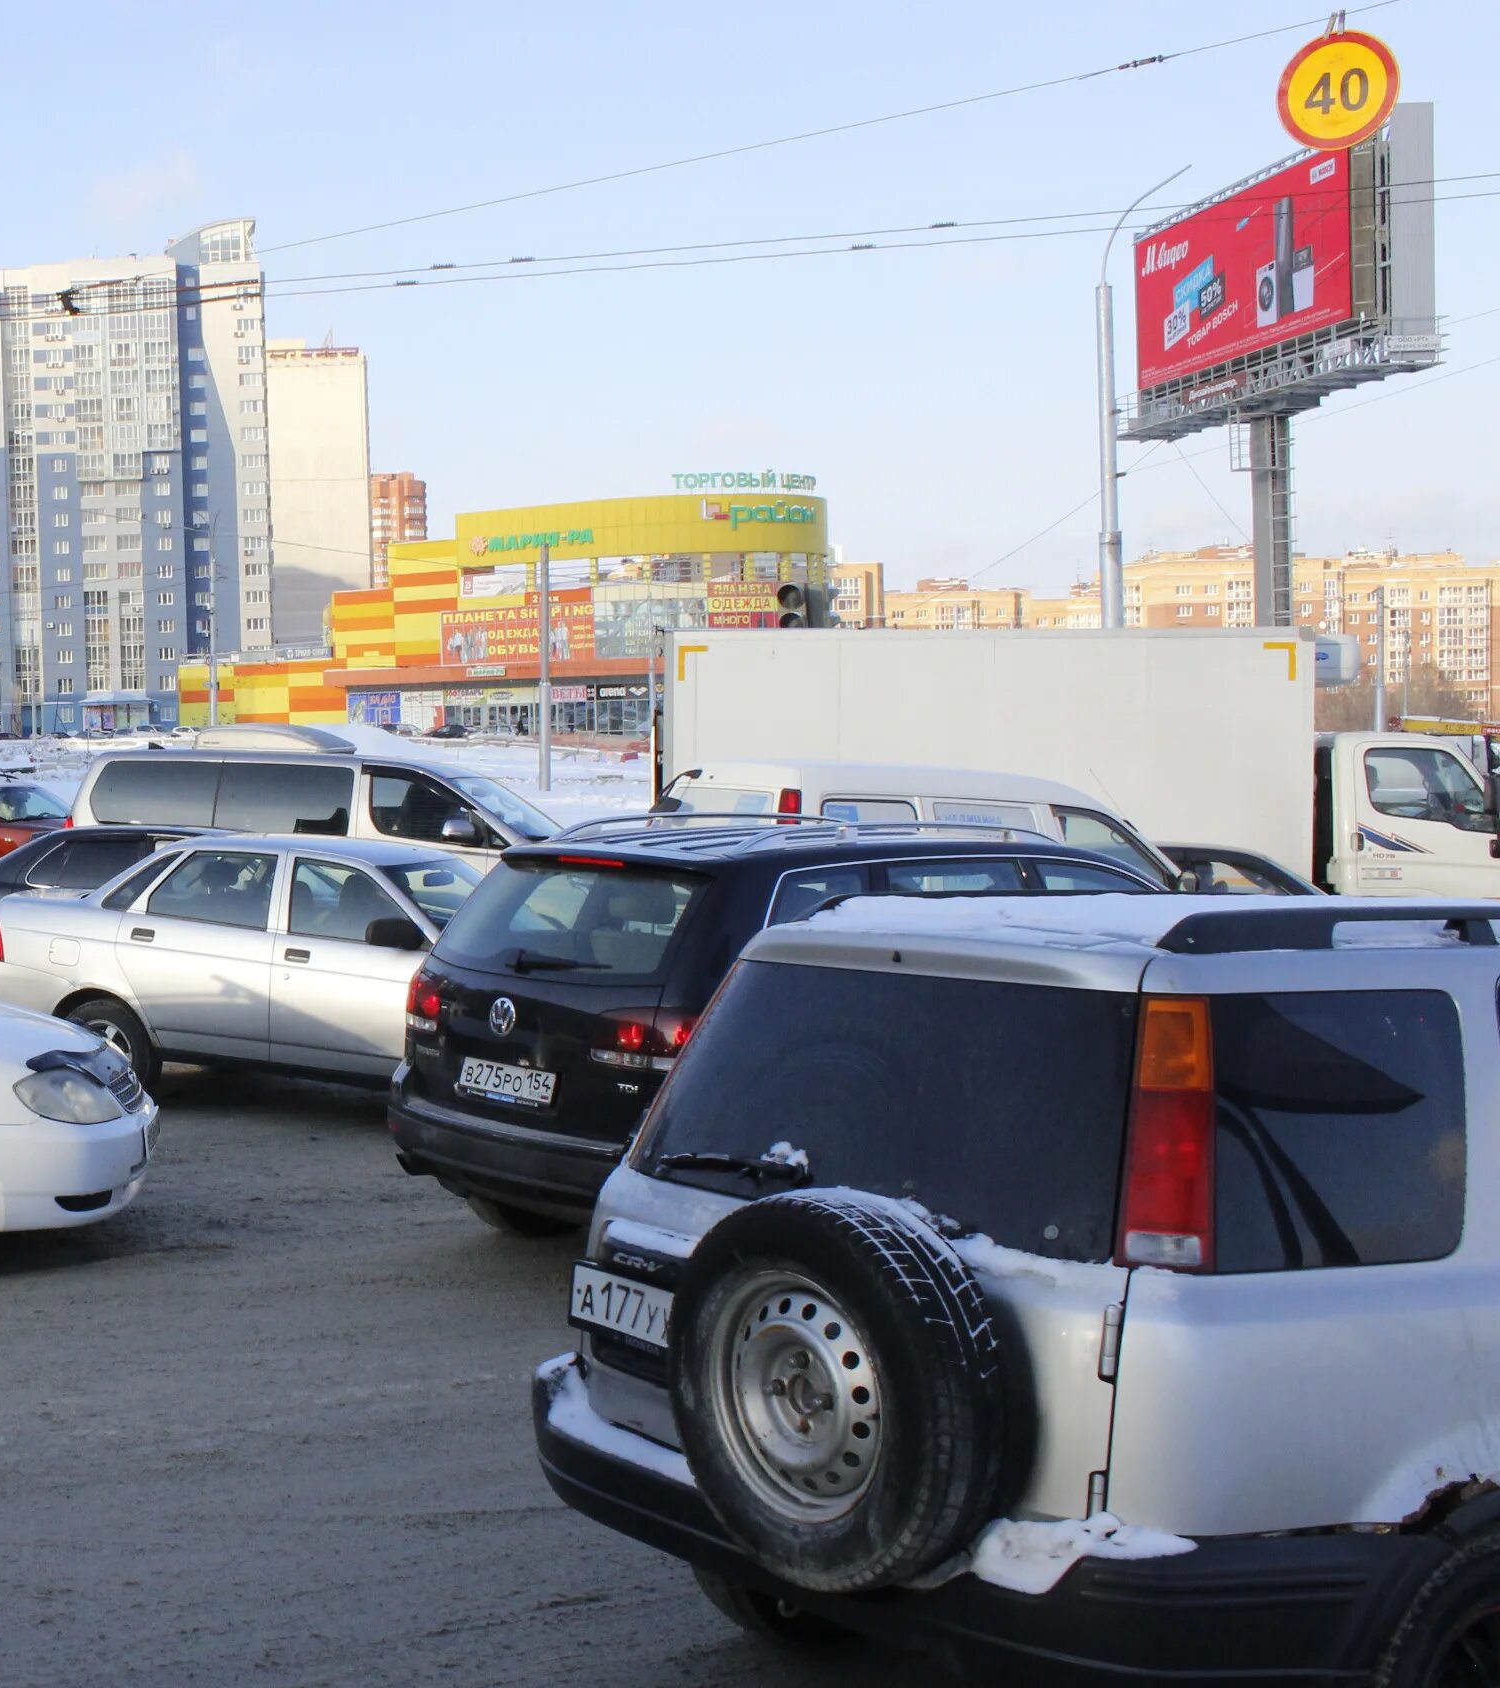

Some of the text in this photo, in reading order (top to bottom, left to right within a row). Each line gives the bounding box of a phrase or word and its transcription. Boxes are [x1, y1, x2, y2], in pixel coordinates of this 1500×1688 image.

[1304, 67, 1369, 115] 40
[1201, 278, 1222, 308] 50%
[1167, 308, 1187, 335] 30%
[1187, 321, 1212, 348] ТОВАР
[1212, 299, 1238, 328] BOSCH
[672, 469, 816, 491] ТОРГОВЫЙ ЦЕНТР
[487, 528, 594, 552] МАРИЯ-РА
[713, 584, 772, 595] ПЛАНЕТА
[532, 594, 540, 603] 2
[711, 598, 771, 610] ОДЕЖДА
[443, 610, 516, 624] ПЛАНЕТА
[713, 615, 750, 625] МНОГО
[487, 629, 539, 640] ОДЕЖДА
[488, 644, 539, 655] ОБУВЬ
[552, 687, 586, 699] ВЕТЫ
[600, 686, 626, 697] arena
[465, 1063, 551, 1092] В275РО 154
[617, 1083, 639, 1094] TDI
